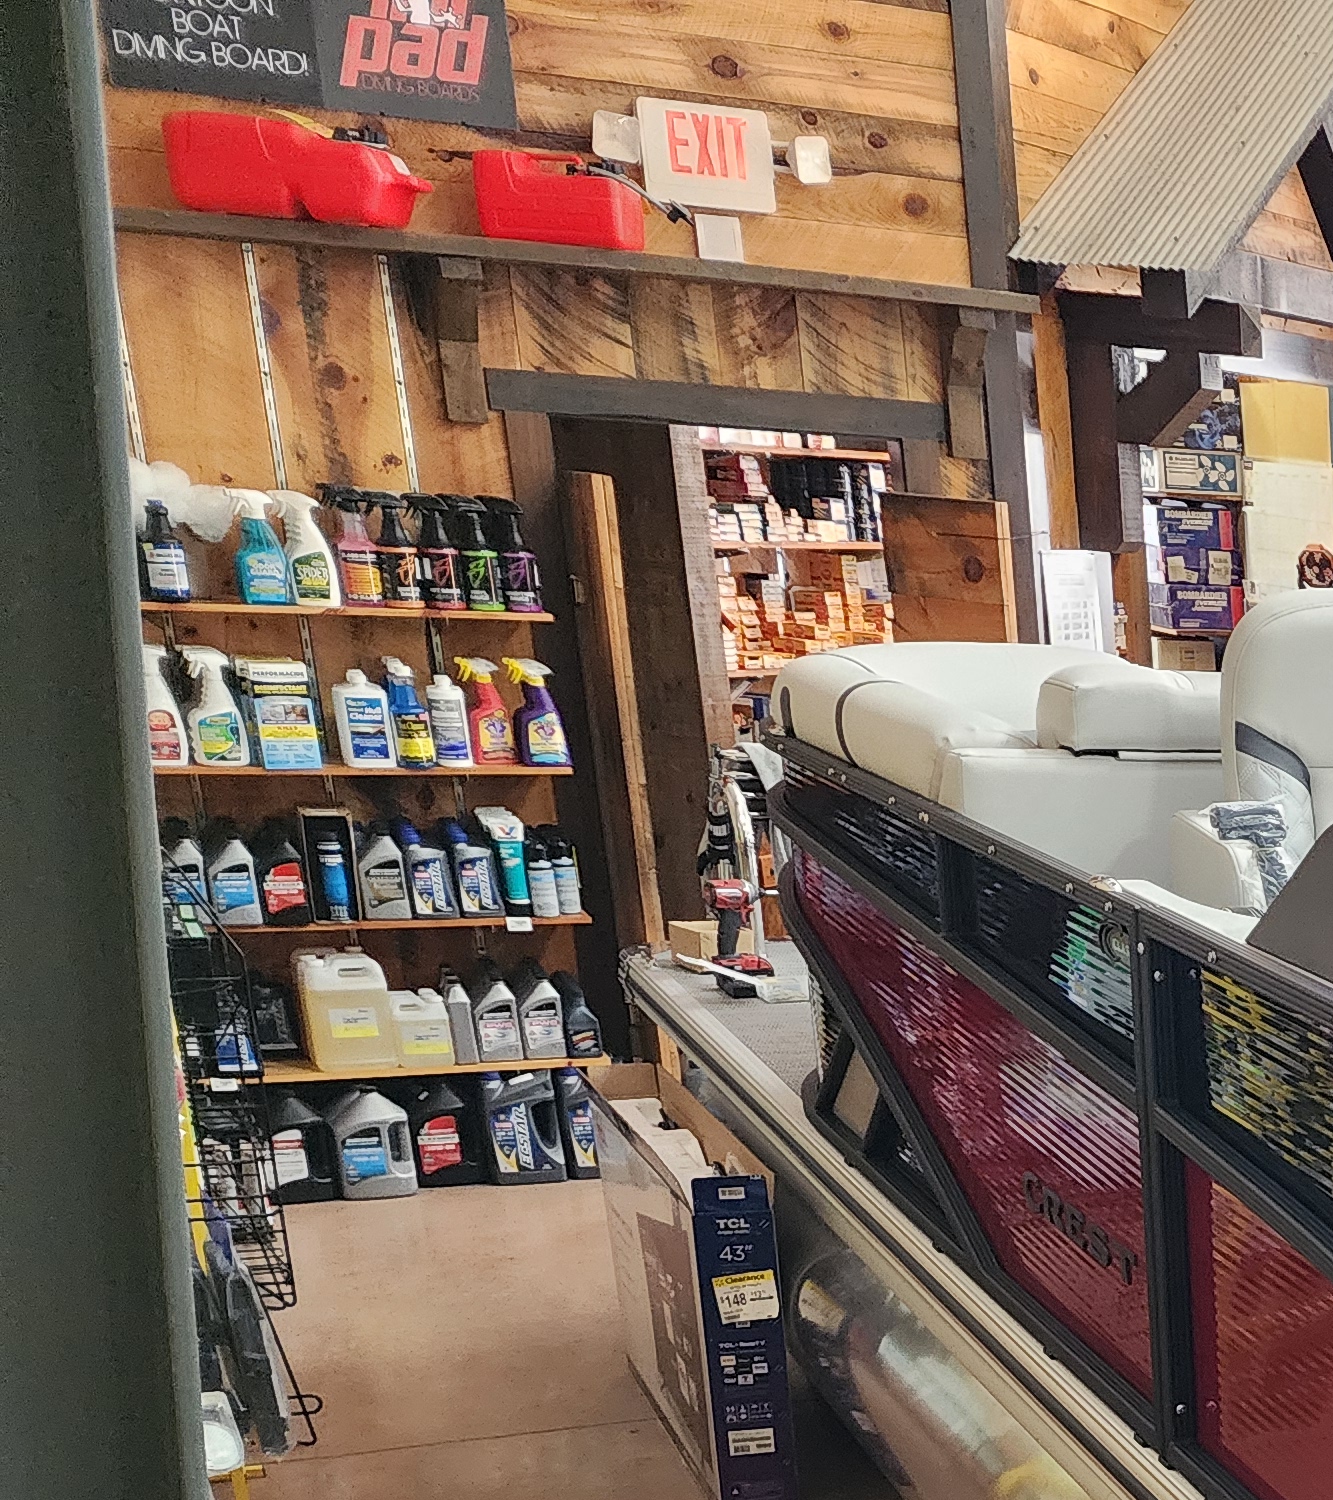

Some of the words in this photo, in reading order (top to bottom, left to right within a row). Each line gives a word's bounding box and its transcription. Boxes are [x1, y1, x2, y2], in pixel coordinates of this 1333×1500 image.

[170, 7, 242, 41] BOAT
[211, 41, 309, 77] BOARD!
[339, 14, 489, 87] pad
[416, 79, 481, 102] BOARDS
[665, 109, 748, 181] EXIT
[296, 567, 329, 580] SPIDER
[716, 1218, 750, 1228] TCL
[1022, 1170, 1138, 1287] CREST
[724, 1273, 766, 1286] Clearance
